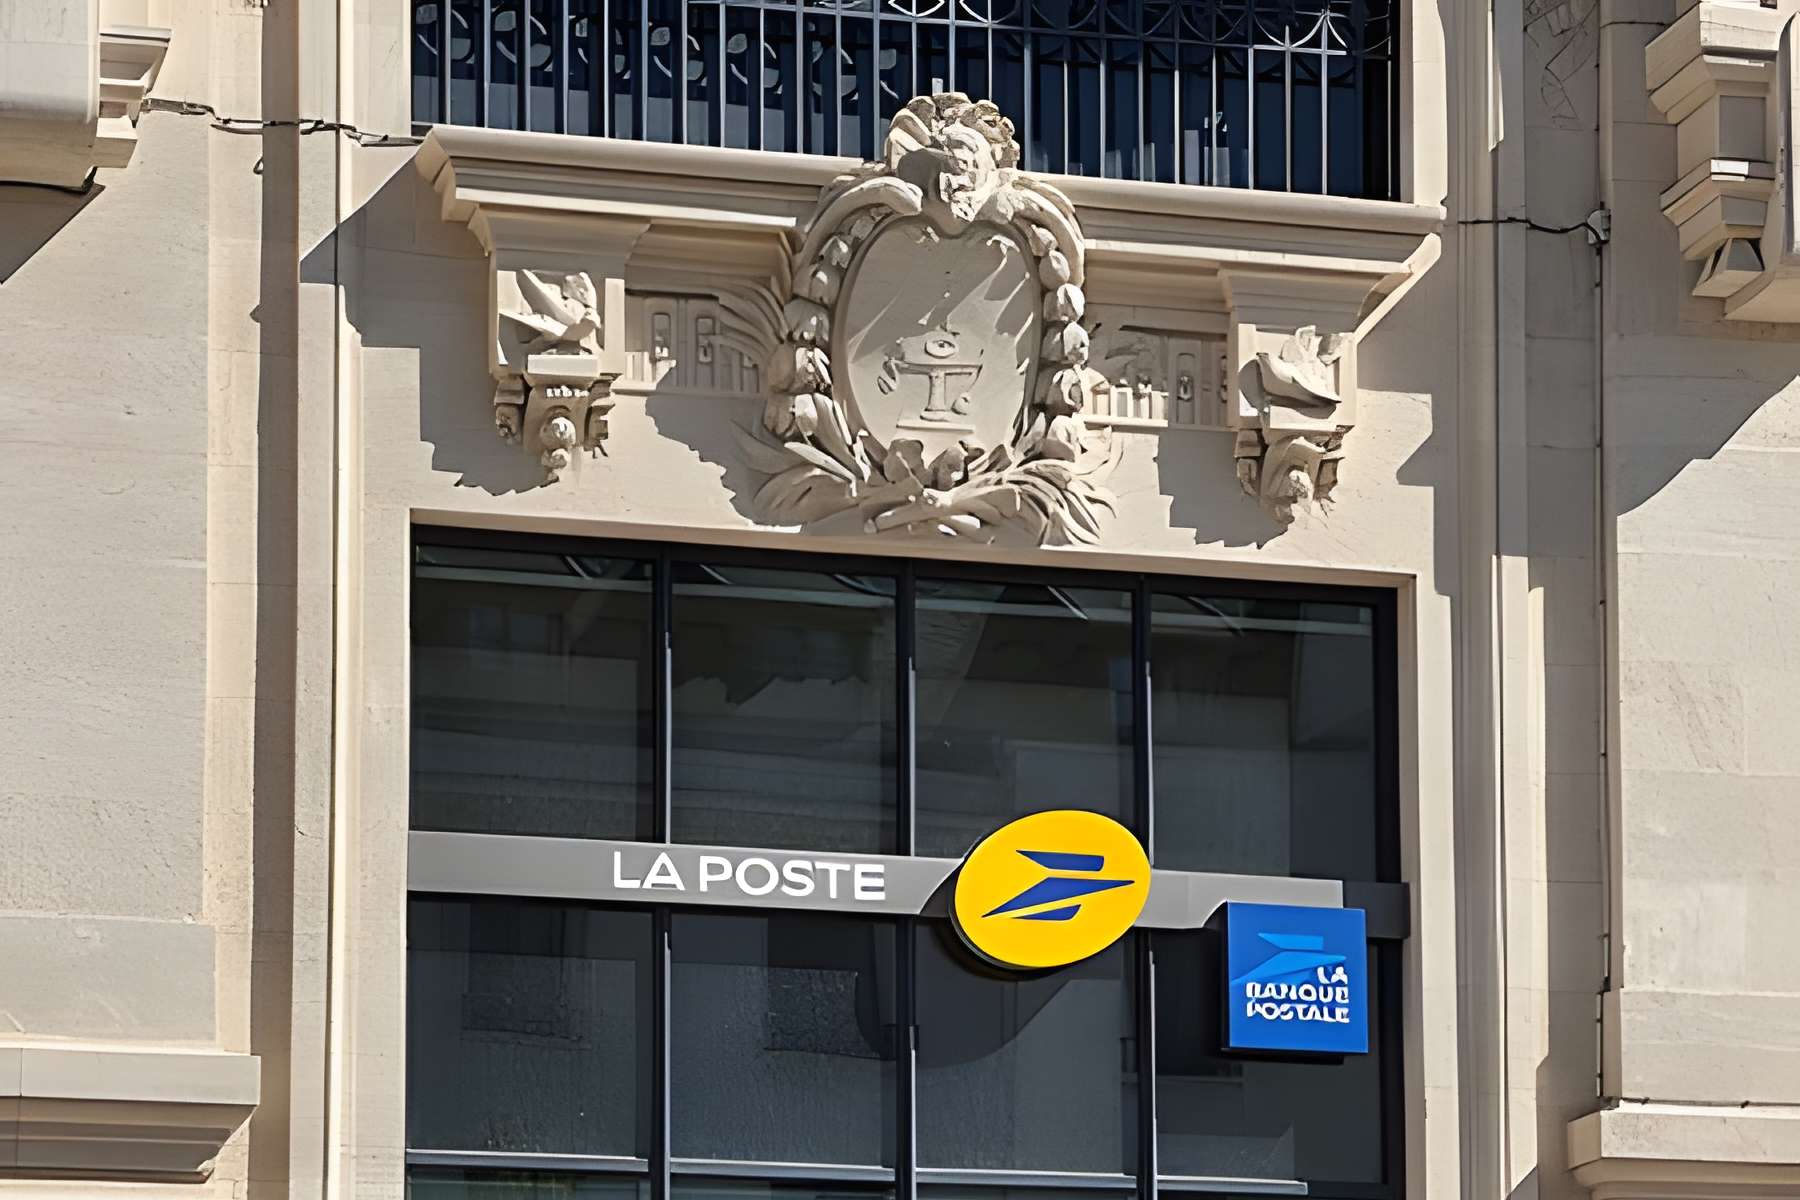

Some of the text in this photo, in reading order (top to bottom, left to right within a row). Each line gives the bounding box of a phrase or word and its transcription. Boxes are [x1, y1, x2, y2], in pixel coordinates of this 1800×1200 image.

[613, 851, 886, 900] LA POSTE
[1317, 966, 1348, 984] LA
